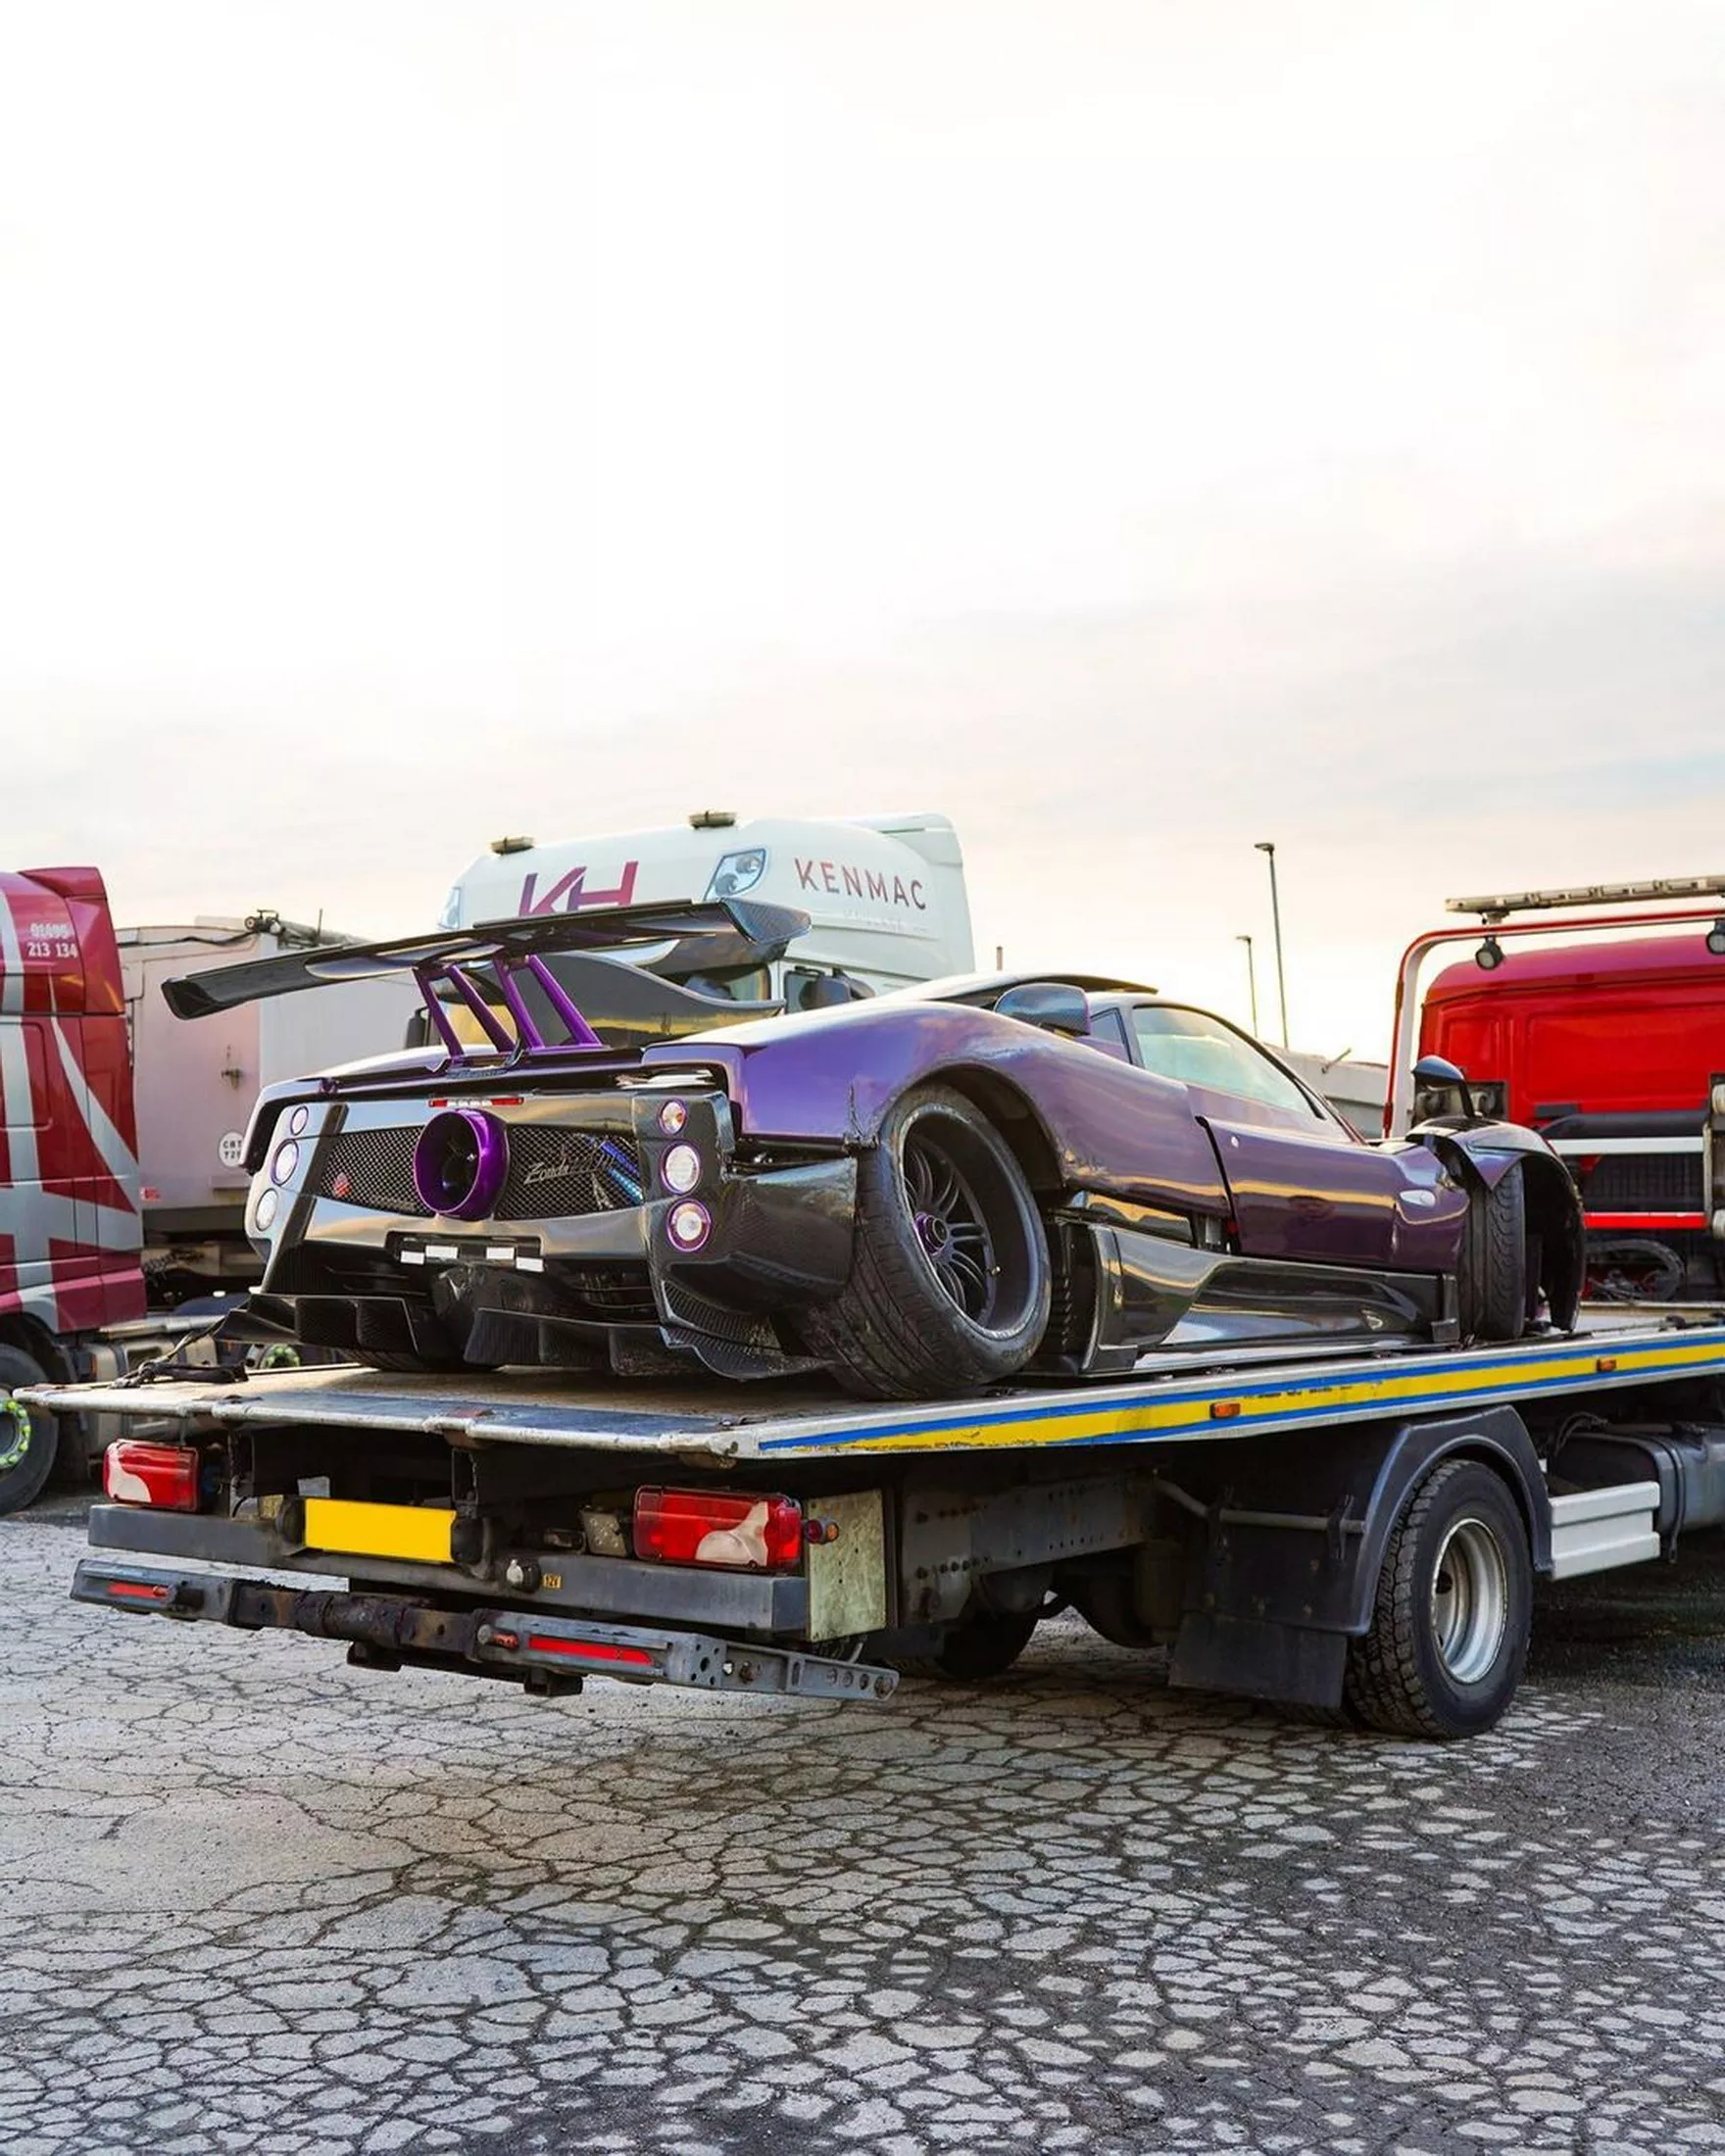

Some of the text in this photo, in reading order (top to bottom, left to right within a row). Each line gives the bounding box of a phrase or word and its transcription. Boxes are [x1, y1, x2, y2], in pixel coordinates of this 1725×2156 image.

[794, 858, 926, 909] KENMAC
[27, 942, 78, 958] 213 134
